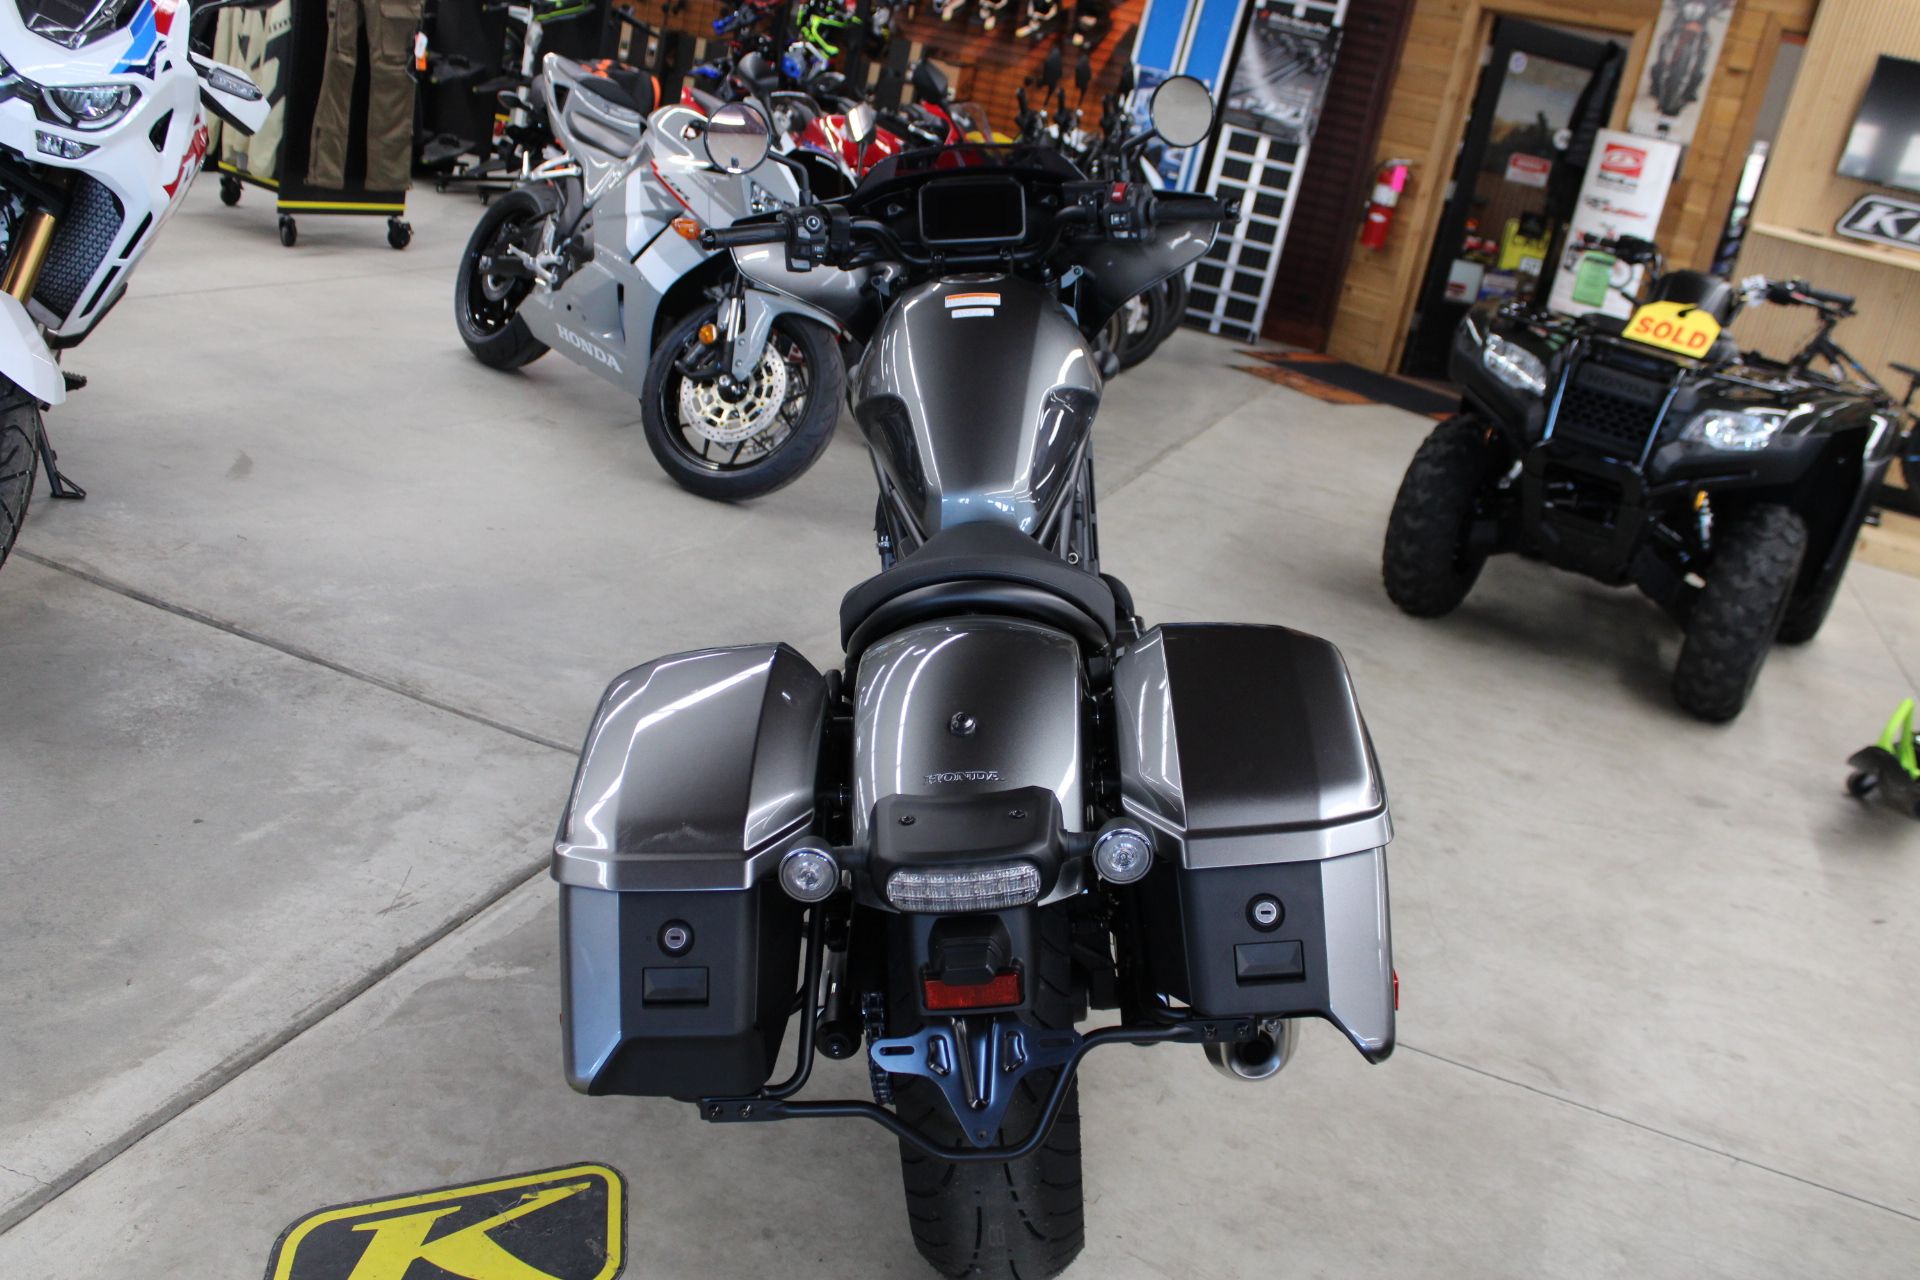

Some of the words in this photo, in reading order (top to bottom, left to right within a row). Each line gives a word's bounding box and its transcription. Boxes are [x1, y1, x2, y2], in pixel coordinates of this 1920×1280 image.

[555, 322, 623, 374] HONDA
[1634, 316, 1709, 349] SOLD
[923, 770, 1003, 785] HONDA
